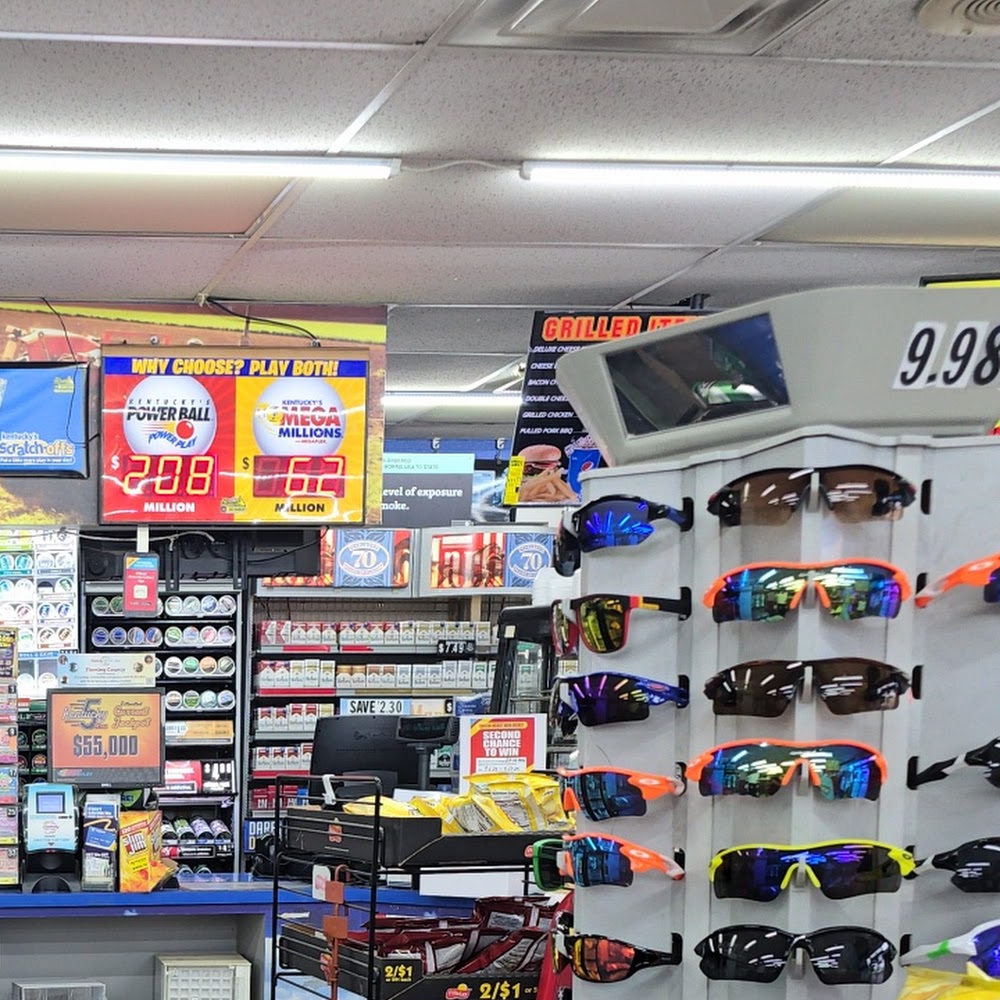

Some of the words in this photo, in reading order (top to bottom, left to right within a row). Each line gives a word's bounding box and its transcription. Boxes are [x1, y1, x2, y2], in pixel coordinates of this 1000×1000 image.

[543, 316, 641, 341] GRILLED
[900, 325, 1000, 386] 9.98
[132, 359, 169, 374] WHY
[172, 359, 244, 376] CHOOSE?
[249, 360, 290, 376] PLAY
[292, 360, 339, 376] BOTH!
[280, 406, 341, 426] MEGA
[148, 431, 177, 444] POWER
[175, 436, 197, 448] PLAY
[278, 428, 342, 438] MILLIONS
[123, 456, 214, 496] 208
[285, 457, 344, 495] 62
[382, 487, 403, 496] evel
[405, 487, 417, 496] of
[417, 489, 463, 499] exposure
[144, 502, 195, 512] MILLION
[275, 503, 325, 512] MILLION
[381, 501, 410, 510] moke.
[350, 701, 375, 712] SAVE
[483, 731, 521, 739] SECOND
[73, 734, 138, 759] $55,000
[483, 740, 521, 748] CHANCE
[485, 748, 497, 757] TO
[498, 748, 519, 756] WIN
[385, 964, 413, 978] 2/$1
[480, 981, 520, 1000] 2/$1
